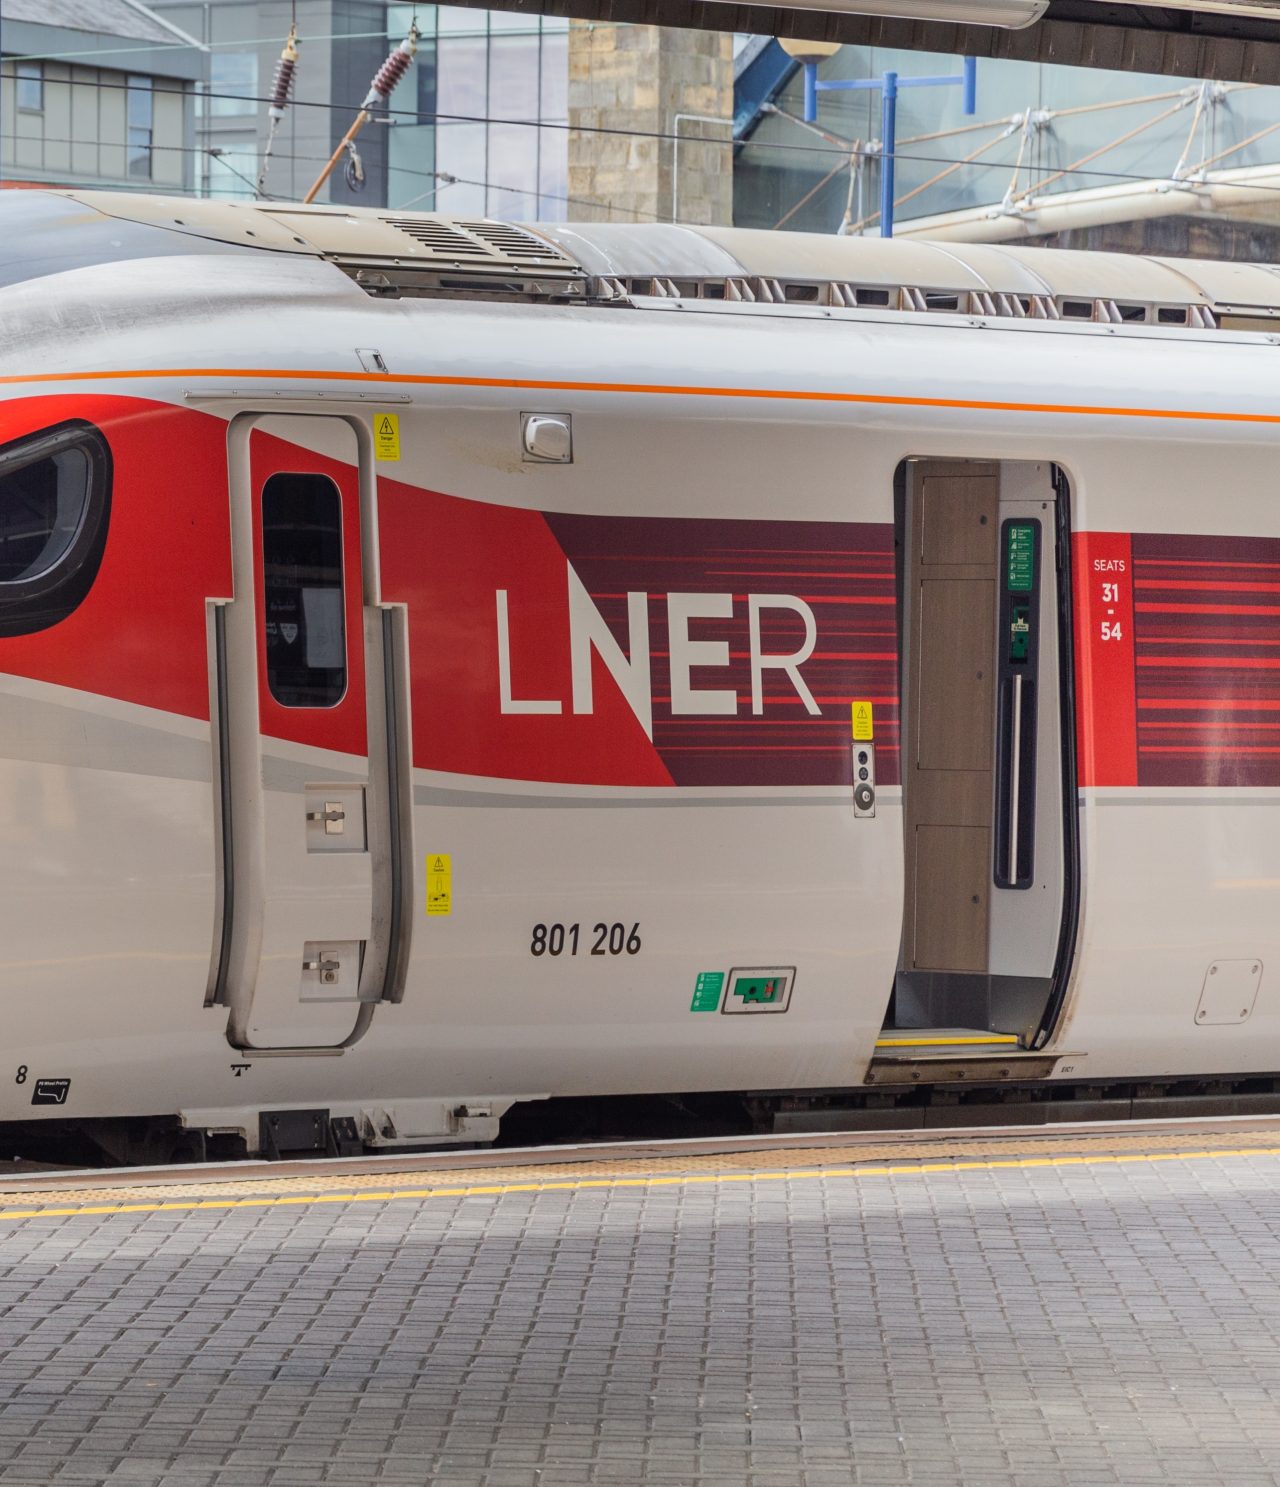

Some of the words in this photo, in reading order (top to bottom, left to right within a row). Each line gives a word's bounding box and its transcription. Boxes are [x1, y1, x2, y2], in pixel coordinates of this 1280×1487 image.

[1094, 559, 1125, 572] SEATS
[1102, 583, 1118, 602] 31
[1101, 621, 1122, 641] 54
[496, 557, 822, 743] LNER
[530, 923, 580, 957] 801
[590, 922, 642, 956] 206
[15, 1064, 28, 1085] 8
